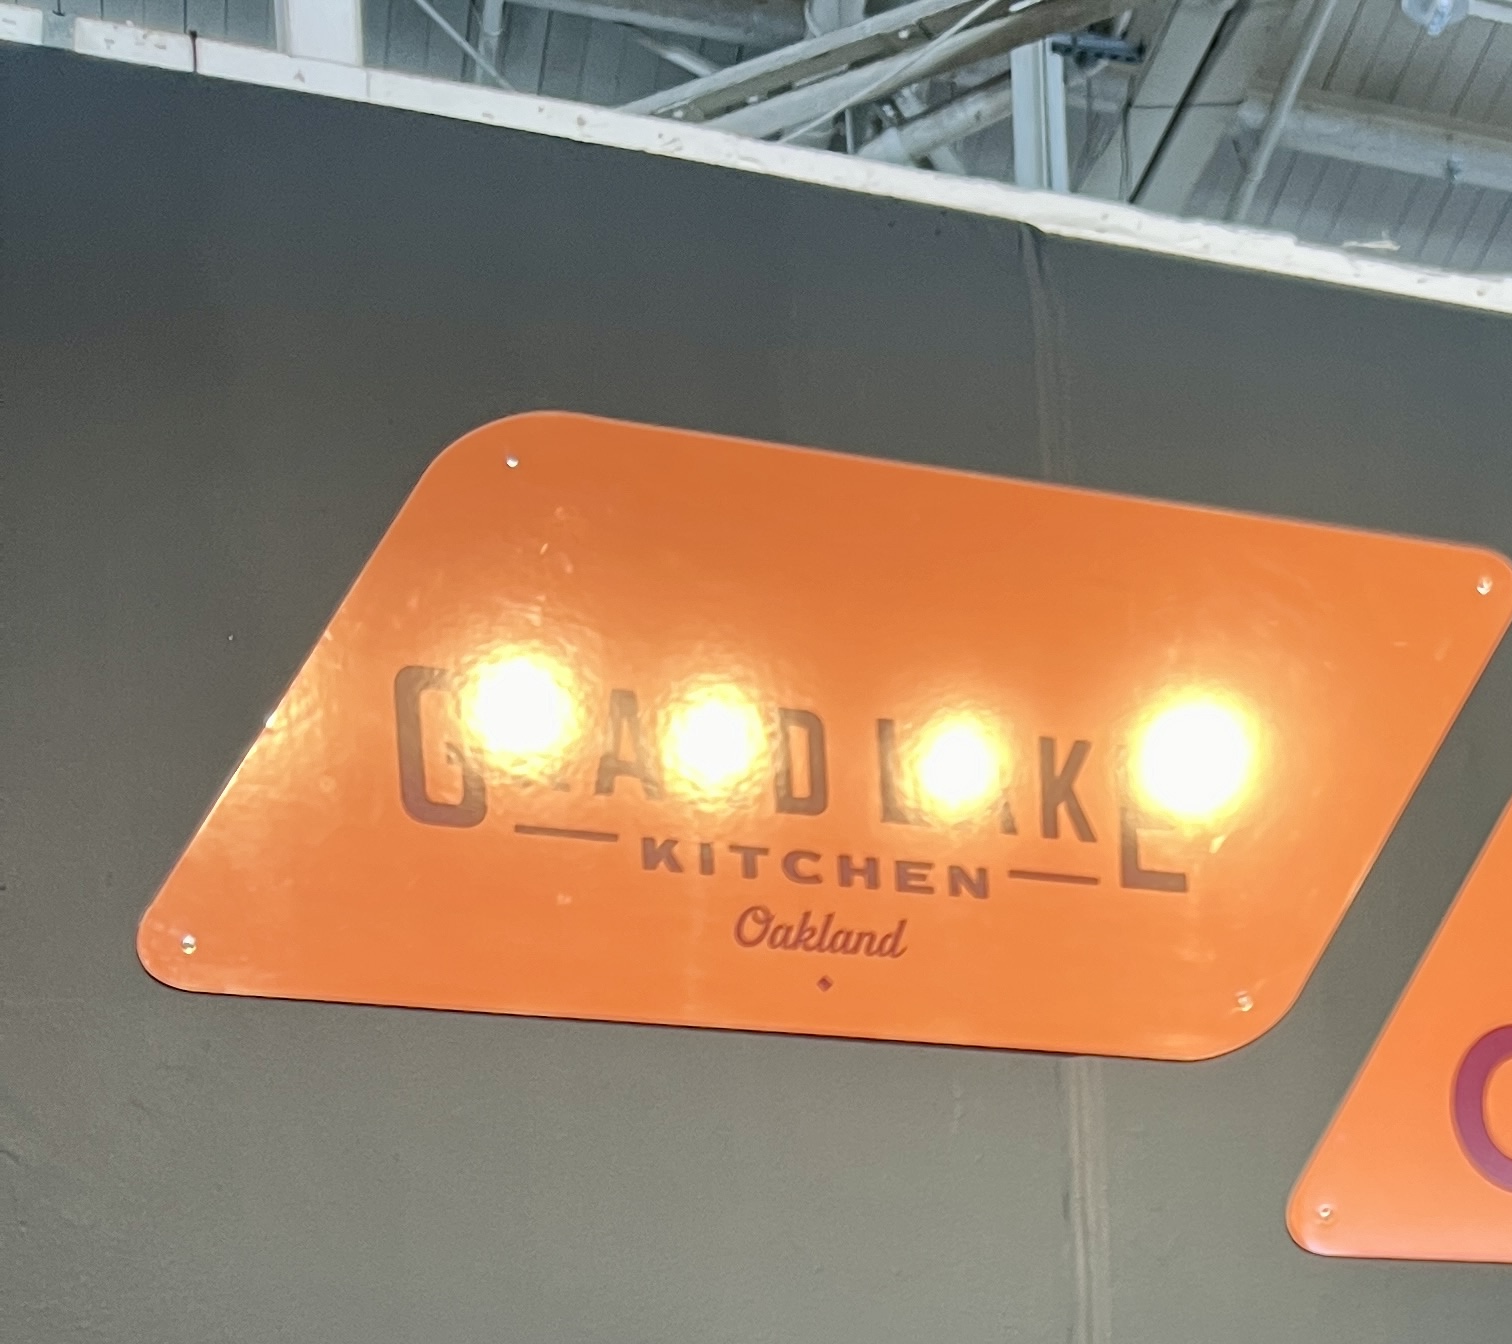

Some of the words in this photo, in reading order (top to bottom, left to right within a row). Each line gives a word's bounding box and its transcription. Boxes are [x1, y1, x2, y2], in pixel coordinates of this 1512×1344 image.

[394, 664, 828, 829] GAD
[876, 717, 1188, 893] LKE
[641, 836, 991, 900] KITCHEN
[733, 904, 908, 959] Oakland
